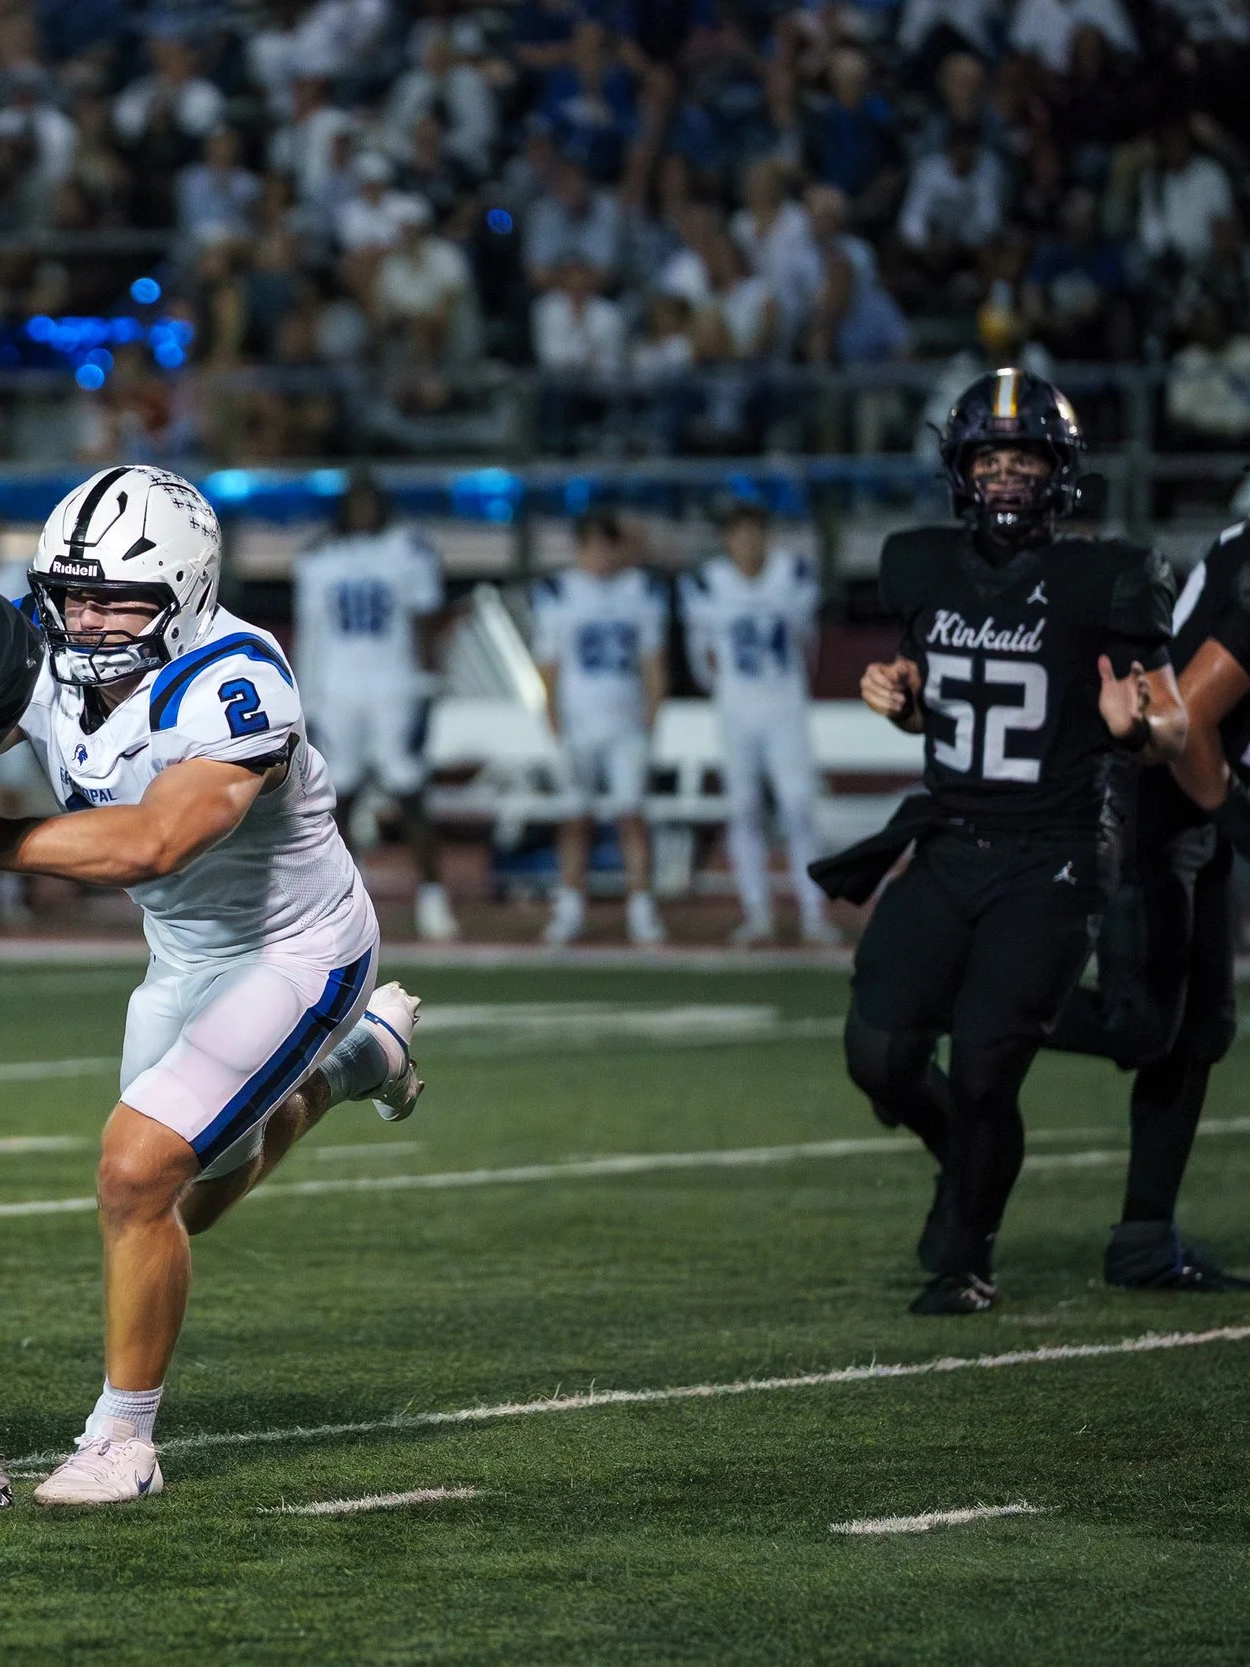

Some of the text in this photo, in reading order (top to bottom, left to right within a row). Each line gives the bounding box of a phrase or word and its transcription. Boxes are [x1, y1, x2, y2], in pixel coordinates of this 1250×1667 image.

[52, 560, 98, 577] Riddell
[926, 608, 1047, 653] Kinkaid
[217, 677, 270, 739] 2
[923, 651, 1049, 783] 52
[59, 766, 118, 802] EPOPAL
